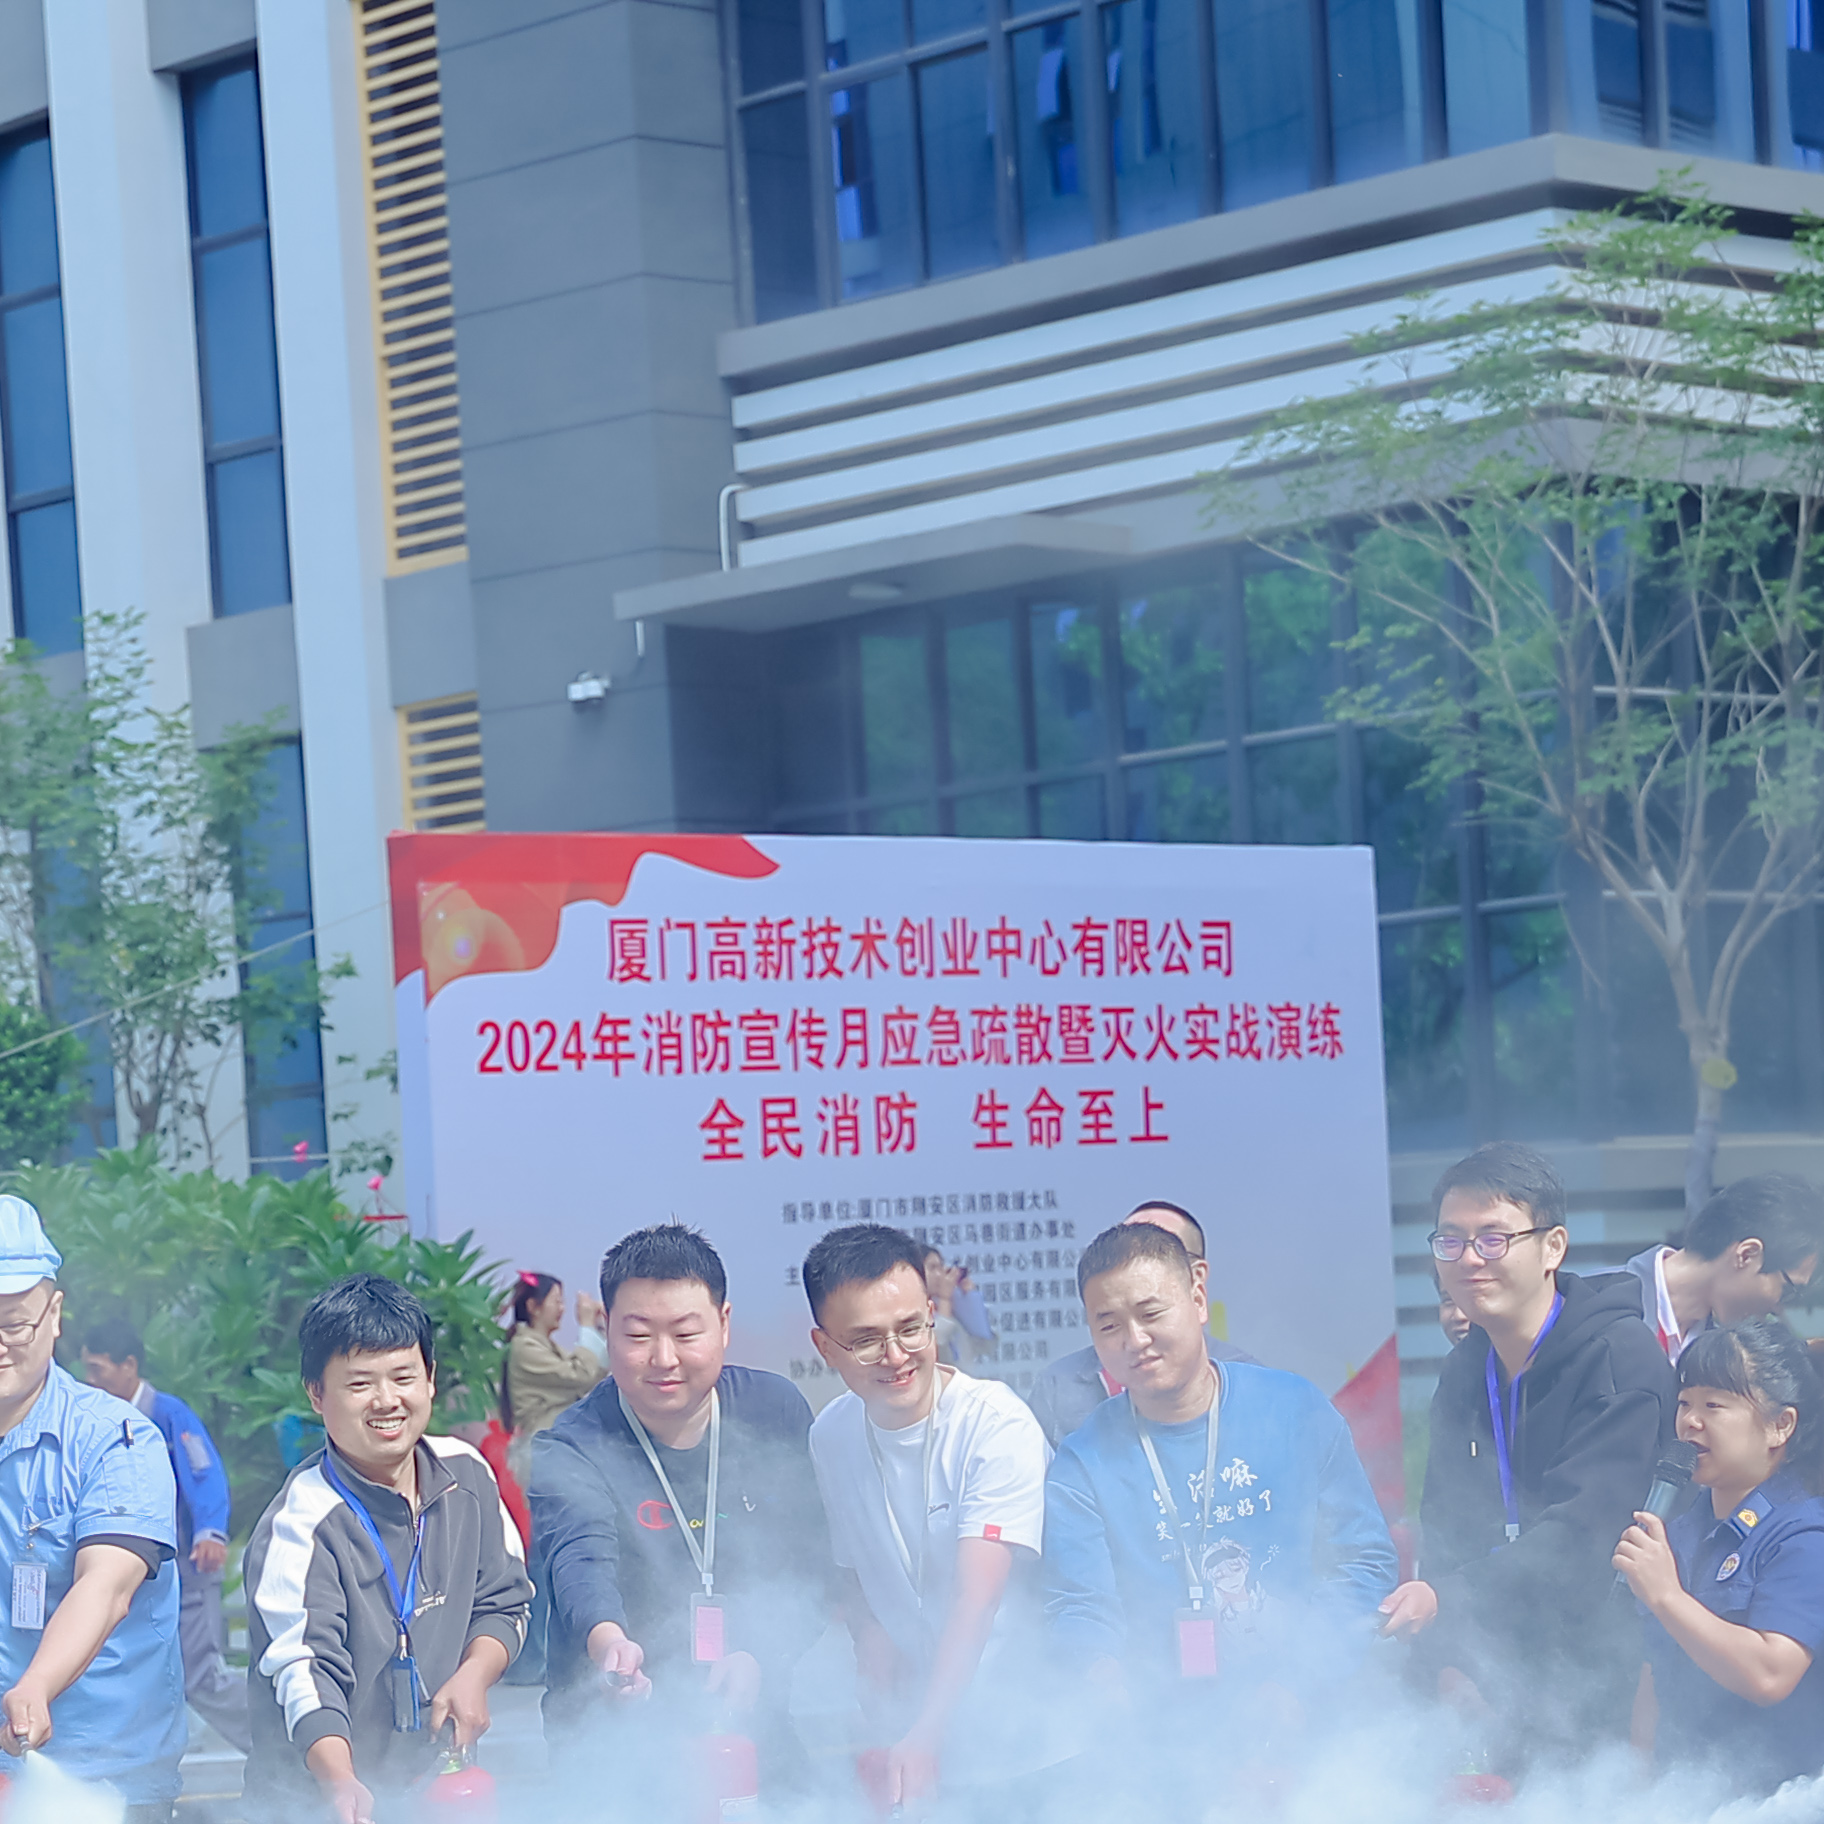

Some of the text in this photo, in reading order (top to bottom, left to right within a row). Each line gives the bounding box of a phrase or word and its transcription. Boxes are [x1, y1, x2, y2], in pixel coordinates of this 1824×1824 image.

[606, 915, 1234, 983] 厦门高新技术创业中心有限公司
[476, 1002, 1345, 1077] 2024年消防宣传月应急疏散暨灭火实战演练
[698, 1085, 1169, 1161] 全民消防 生命至上
[900, 1219, 1076, 1248] 翔安区马巷街道办事处
